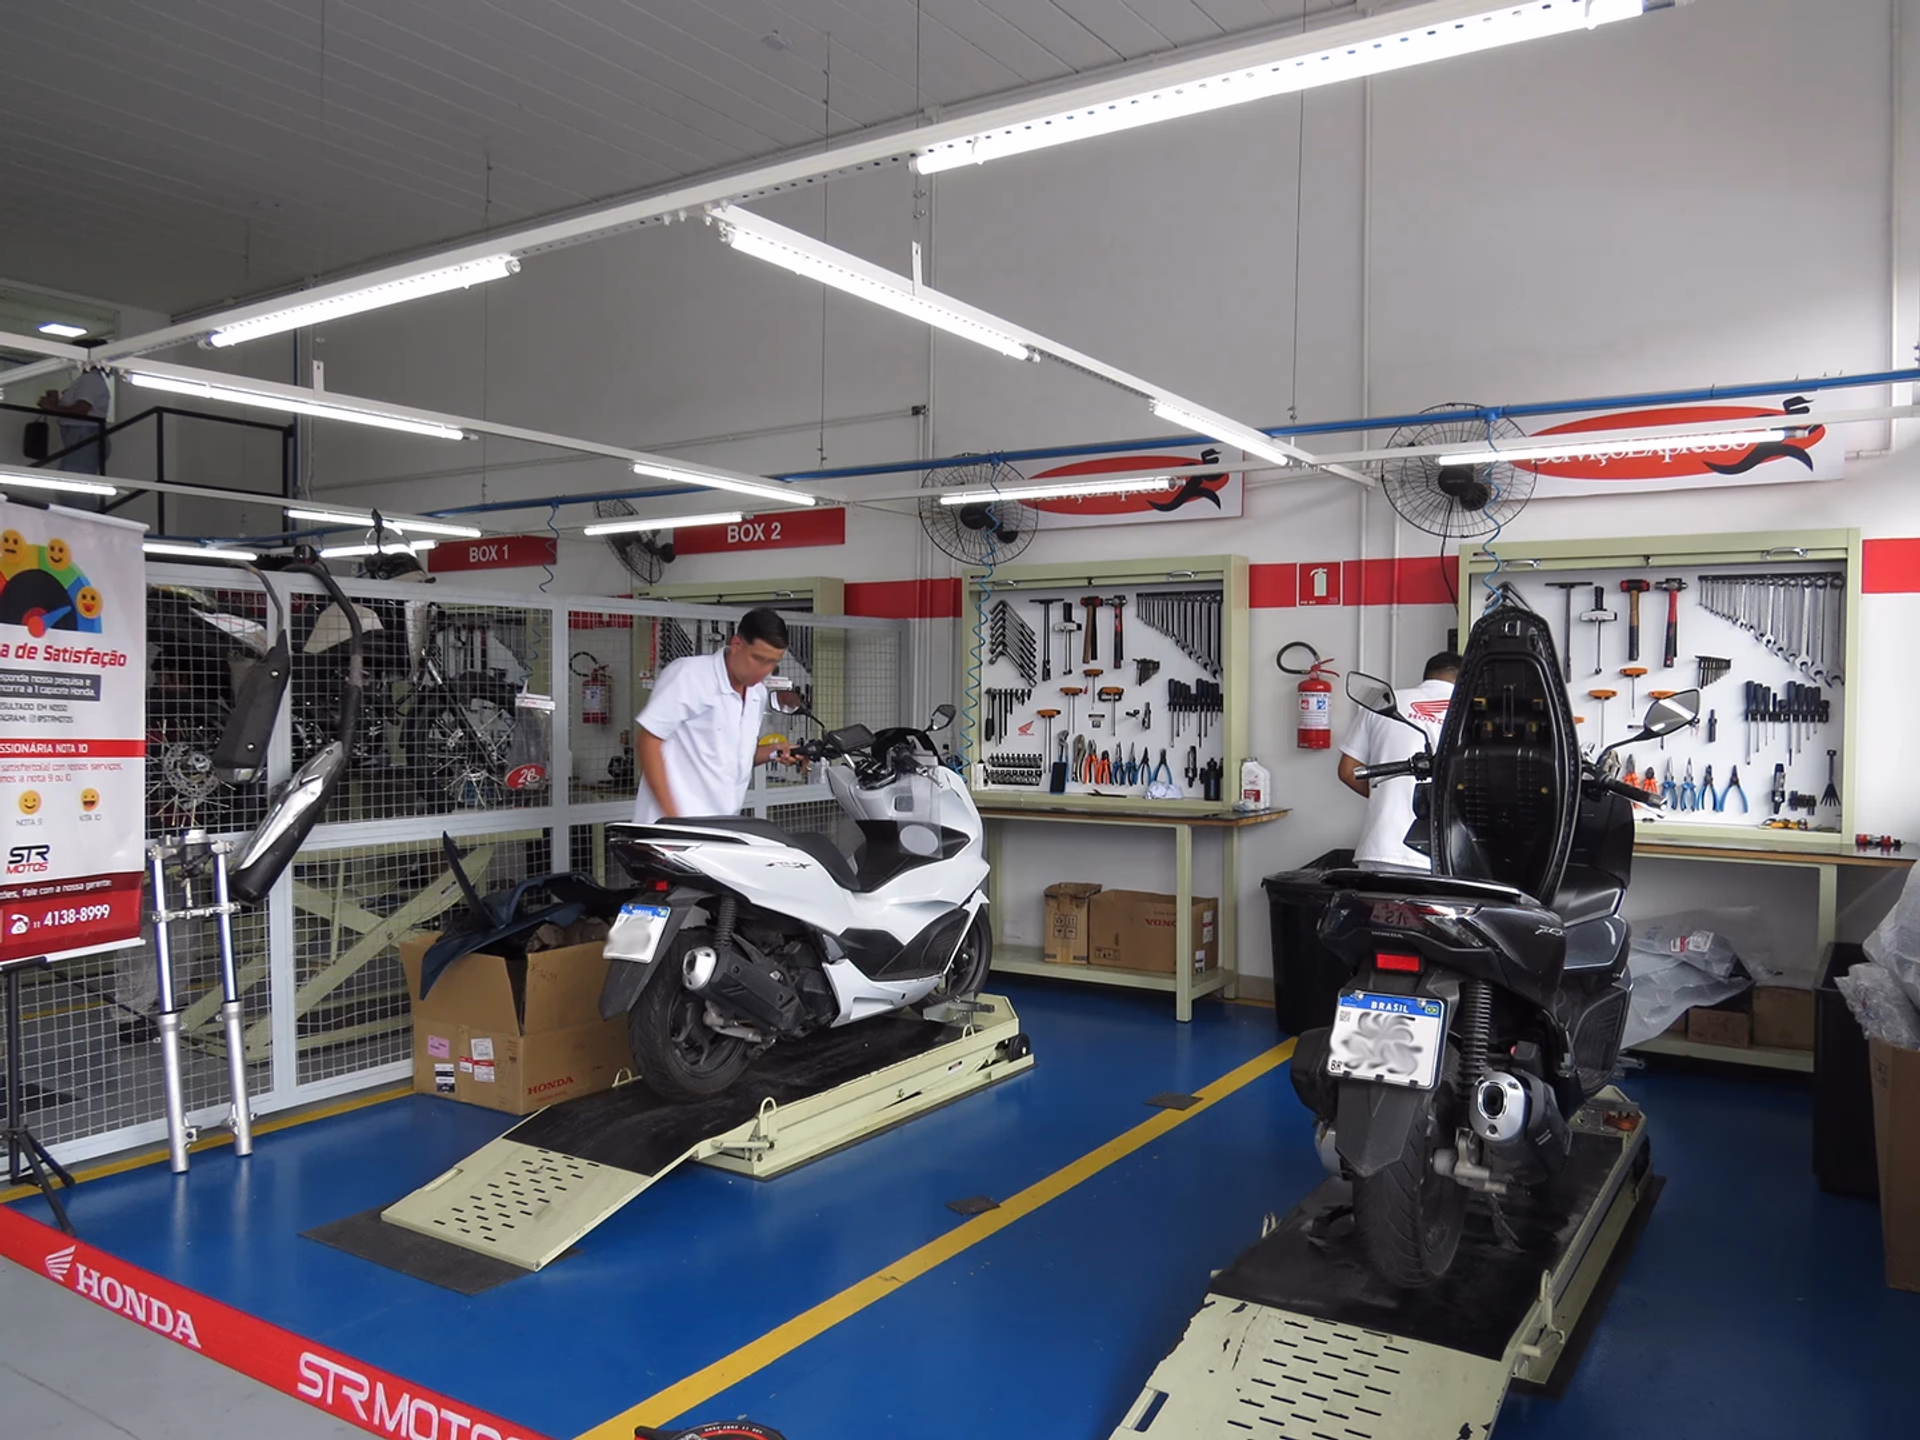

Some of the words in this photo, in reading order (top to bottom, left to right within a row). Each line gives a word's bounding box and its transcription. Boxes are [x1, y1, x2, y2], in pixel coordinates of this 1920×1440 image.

[727, 523, 767, 543] BOX
[769, 523, 782, 540] 2
[469, 546, 498, 562] BOX
[502, 544, 510, 560] 1
[15, 643, 38, 660] de
[43, 645, 127, 668] Satisfação
[56, 744, 76, 753] NOTA
[79, 744, 88, 753] 10
[8, 845, 50, 864] STR
[6, 862, 48, 875] MOTOS
[22, 887, 38, 897] fale
[40, 886, 54, 895] com
[43, 904, 110, 927] 4138-8999
[1371, 1001, 1409, 1013] BRASIL
[528, 1076, 574, 1096] HONDA
[76, 1263, 202, 1349] HONDA
